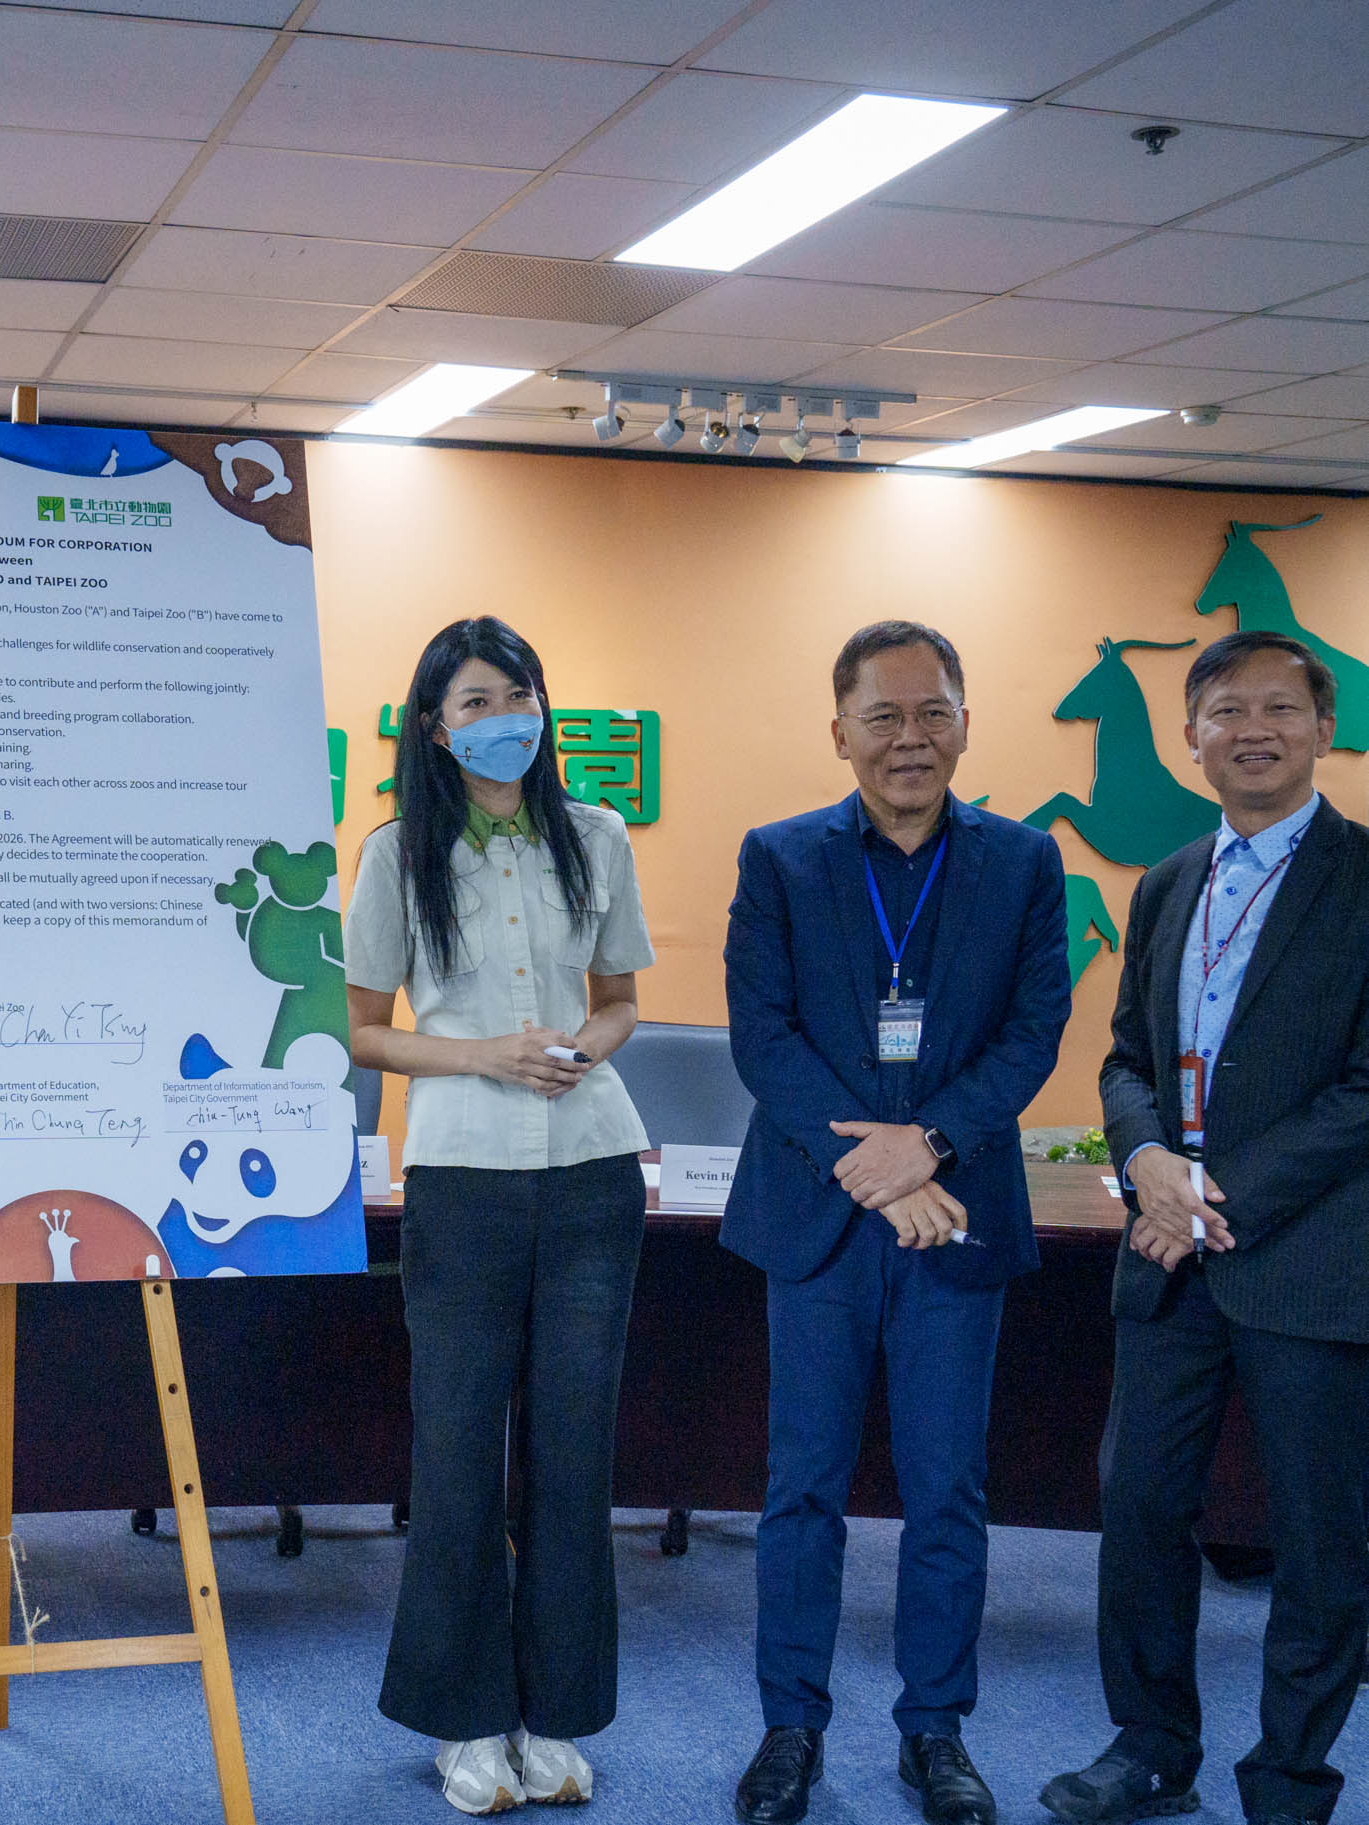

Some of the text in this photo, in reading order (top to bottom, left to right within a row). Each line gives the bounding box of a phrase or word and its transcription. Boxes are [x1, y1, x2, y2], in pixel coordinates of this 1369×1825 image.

[70, 512, 172, 527] TAIPEI ZOO
[28, 535, 56, 548] FOR
[58, 536, 153, 552] CORPORATION
[7, 572, 32, 585] and
[34, 573, 77, 586] TAIPEI
[80, 575, 108, 588] ZOO
[13, 601, 59, 614] Houston
[61, 603, 82, 615] Zoo
[84, 604, 107, 618] ("A")
[109, 605, 130, 617] and
[133, 606, 164, 620] Taipei
[165, 607, 186, 619] Zoo
[187, 608, 213, 622] ("B")
[214, 608, 240, 621] have
[241, 612, 270, 622] come
[271, 610, 283, 622] to
[55, 638, 70, 650] for
[72, 639, 111, 652] wildlife
[112, 640, 181, 654] conservation
[182, 643, 203, 655] and
[205, 643, 274, 659] cooperatively
[5, 675, 17, 686] to
[18, 675, 75, 688] contribute
[76, 677, 98, 689] and
[99, 678, 143, 693] perform
[144, 679, 163, 691] the
[164, 680, 213, 695] following
[214, 681, 249, 696] jointly:
[0, 708, 21, 720] and
[23, 708, 72, 723] breeding
[73, 713, 120, 725] program
[121, 711, 195, 725] collaboration.
[3, 809, 14, 820] B.
[12, 871, 28, 883] be
[29, 871, 79, 886] mutually
[80, 872, 119, 886] agreed
[120, 875, 150, 886] upon
[151, 873, 159, 884] if
[160, 876, 216, 889] necessary.
[6, 1004, 25, 1013] Zoo
[37, 1080, 48, 1089] of
[49, 1080, 99, 1091] Education,
[162, 1081, 213, 1093] Department
[213, 1081, 223, 1091] of
[223, 1080, 272, 1091] Information
[272, 1080, 289, 1090] and
[9, 1092, 29, 1103] City
[30, 1092, 89, 1102] Government
[163, 1092, 259, 1105] Taipei City Government
[686, 1170, 718, 1181] Kevin
